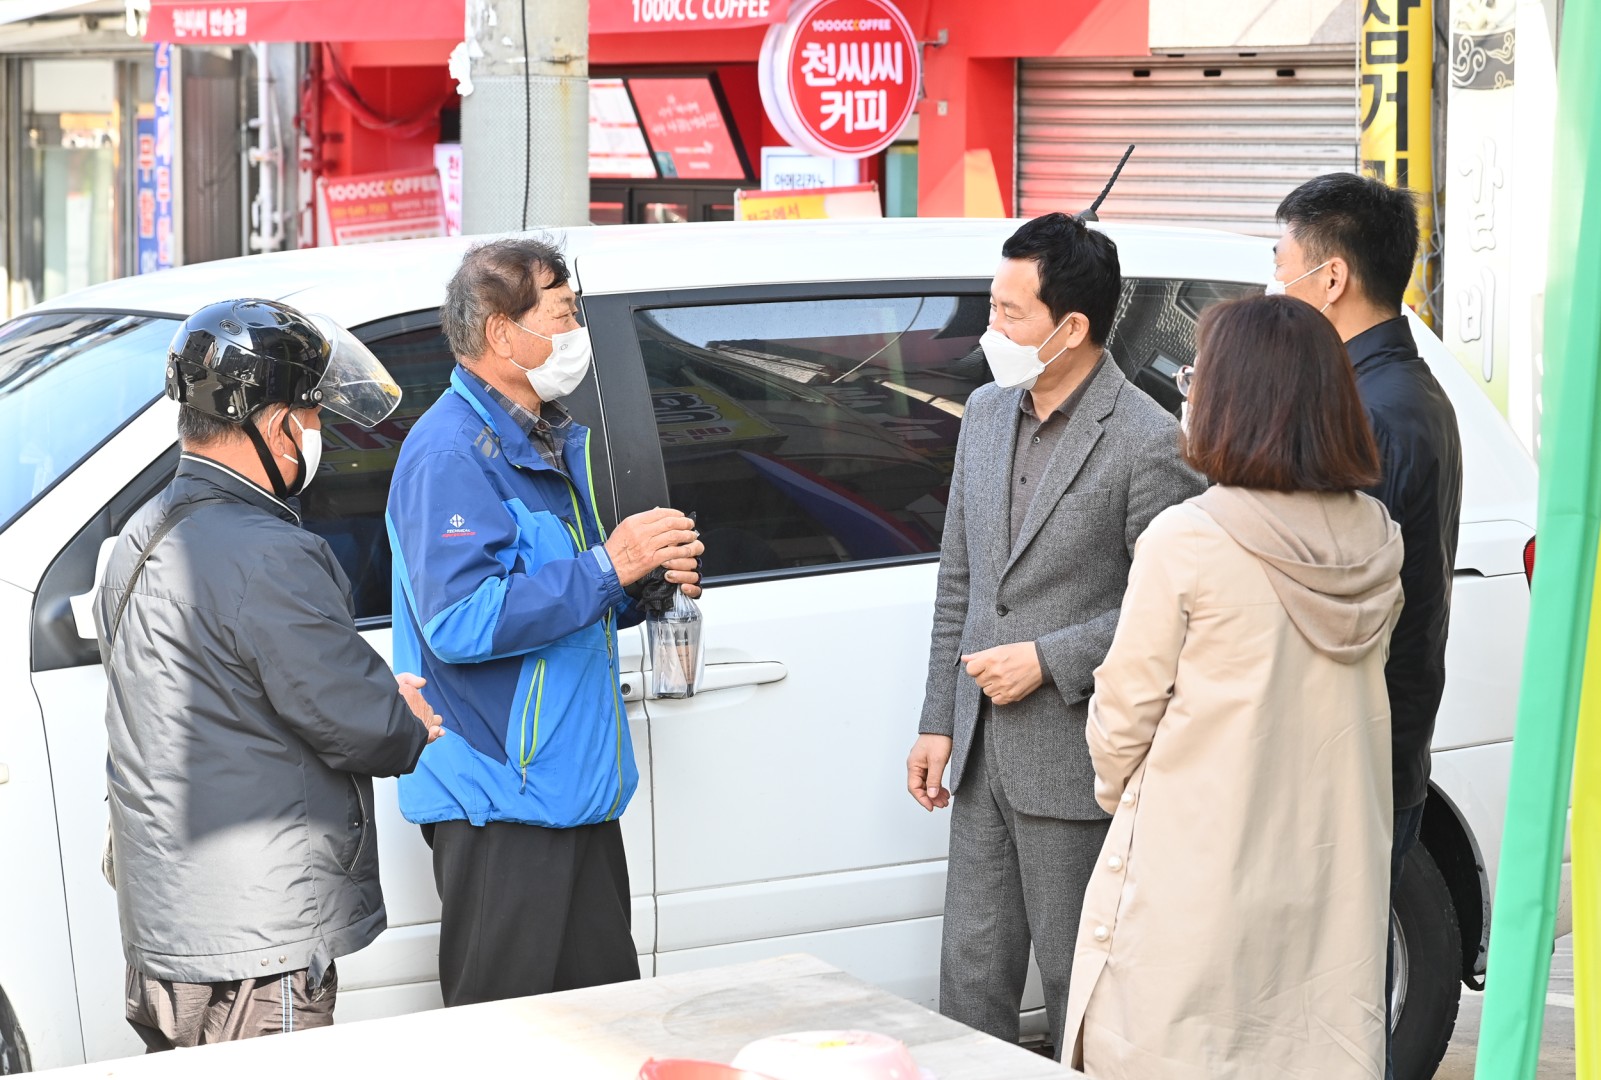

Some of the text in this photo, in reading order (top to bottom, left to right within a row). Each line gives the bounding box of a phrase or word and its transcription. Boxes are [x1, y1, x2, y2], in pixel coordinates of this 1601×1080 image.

[632, 0, 769, 23] 1000CC COFFEE
[802, 42, 904, 86] 천씨씨
[820, 90, 887, 133] 커피
[774, 174, 825, 190] 아메리카노
